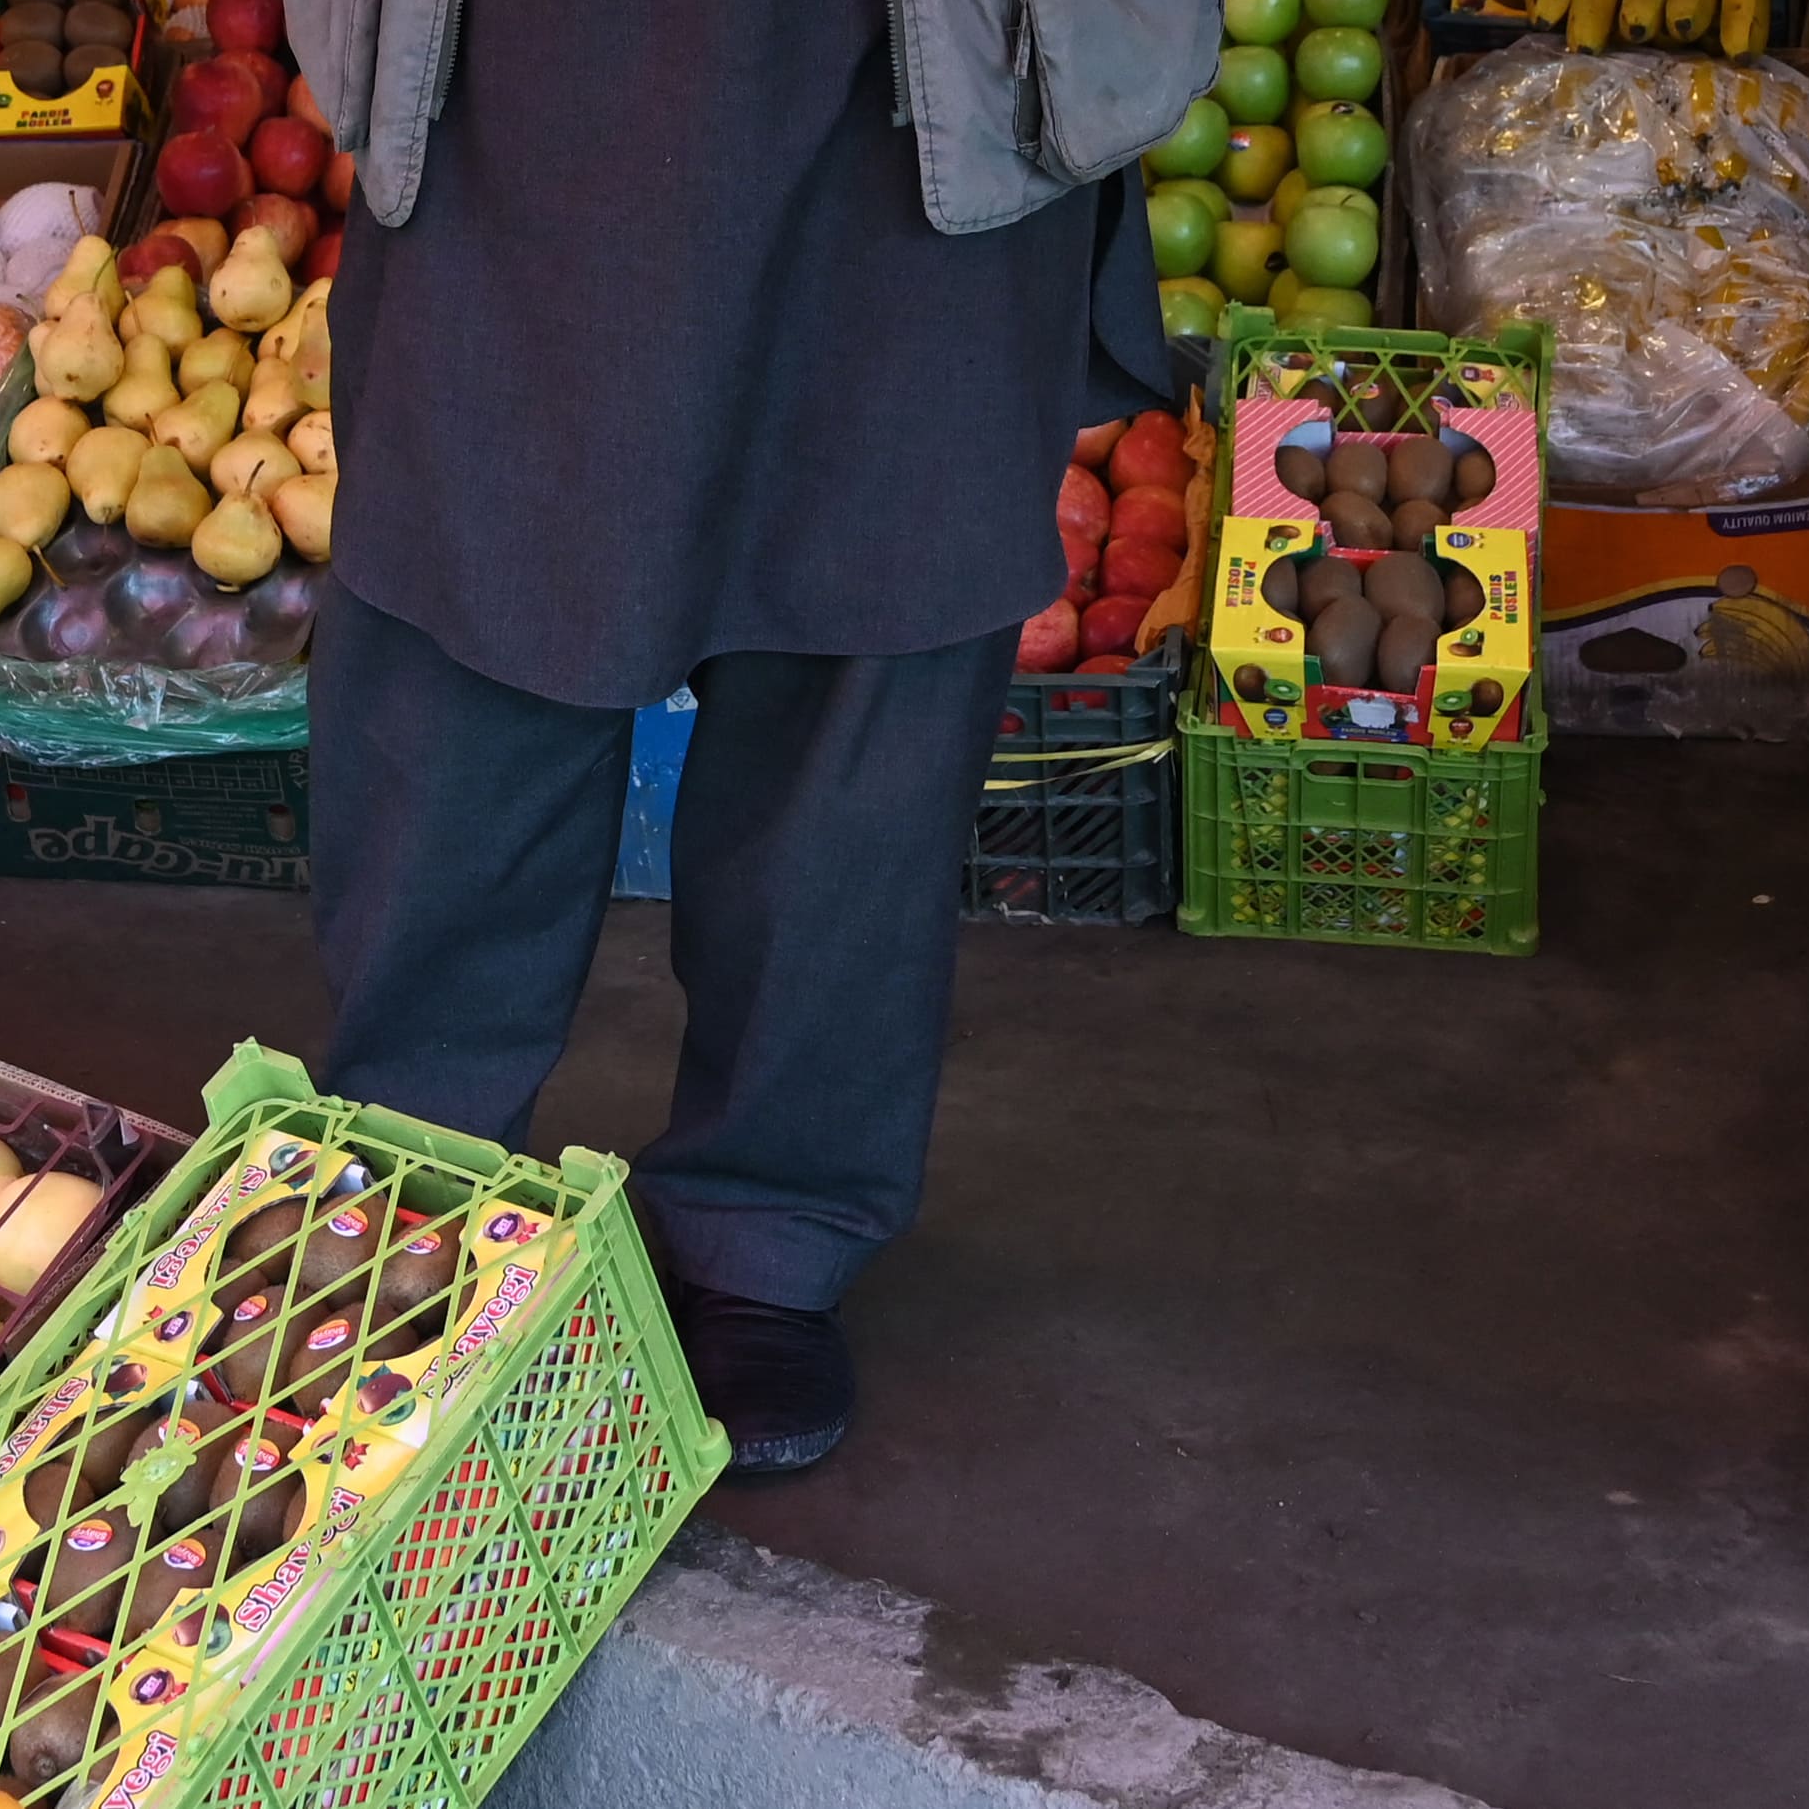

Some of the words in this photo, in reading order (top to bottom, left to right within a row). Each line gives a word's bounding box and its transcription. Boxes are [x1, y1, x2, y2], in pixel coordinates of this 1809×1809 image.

[1722, 514, 1771, 530] QUALITY
[1225, 556, 1244, 608] MOSLEM
[1240, 560, 1258, 607] PARDIS
[1489, 573, 1504, 622] PARDIS
[1503, 570, 1518, 624] MOSLEM
